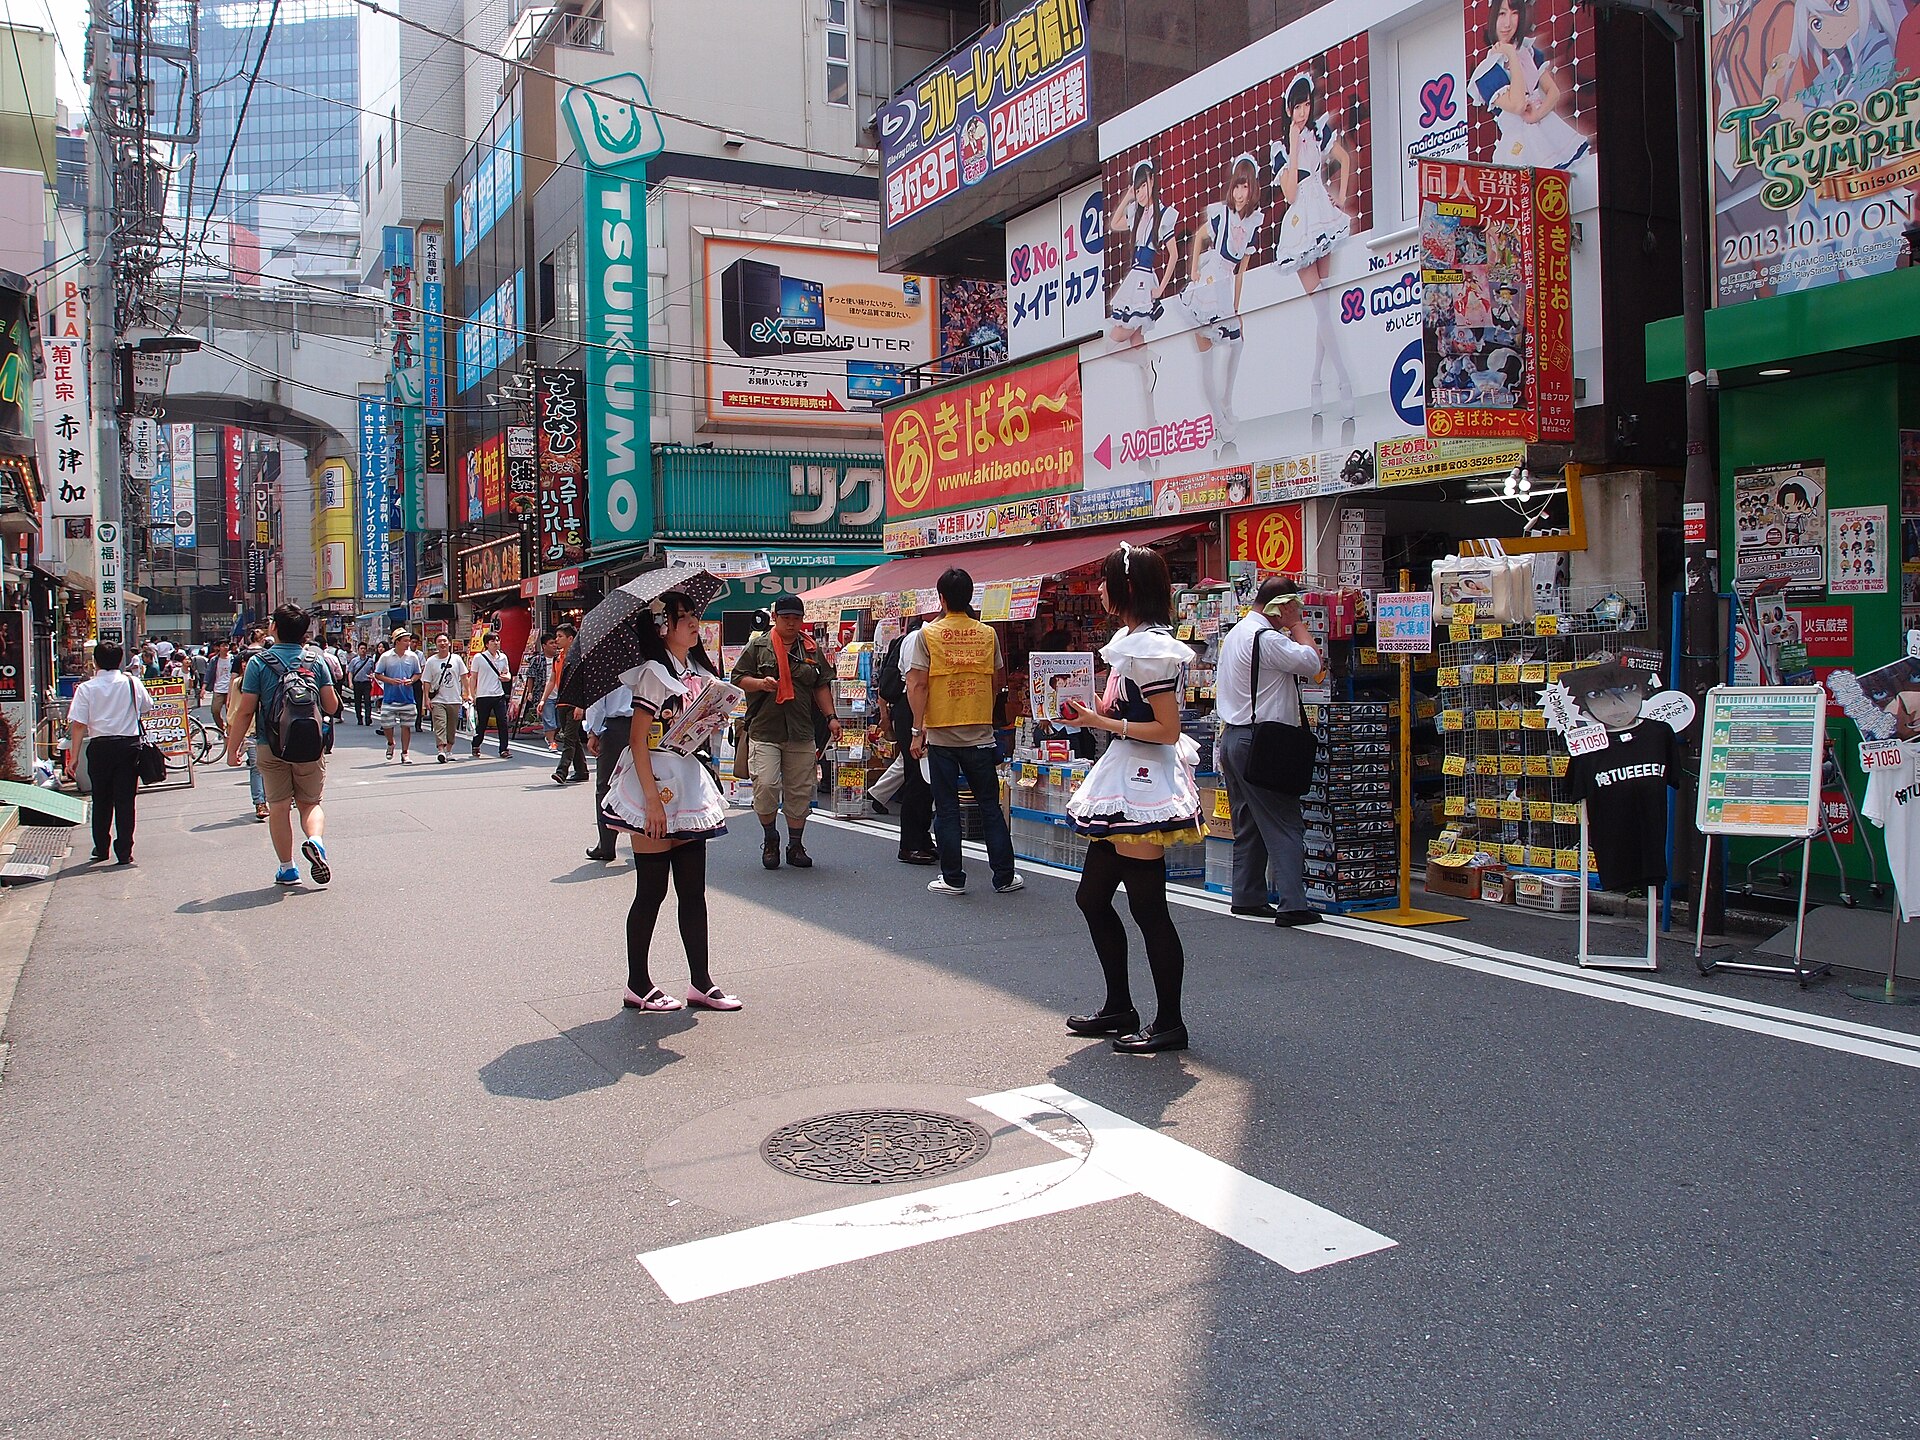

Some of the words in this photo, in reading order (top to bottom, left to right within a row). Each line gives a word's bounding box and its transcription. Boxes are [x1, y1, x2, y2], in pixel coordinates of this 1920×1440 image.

[993, 66, 1084, 162] 24時間営業
[889, 140, 956, 221] 受付3F
[1422, 163, 1476, 202] 同人
[1478, 169, 1518, 196] 音楽
[1847, 160, 1920, 195] Unisona
[1479, 196, 1521, 217] ソフト
[1478, 214, 1522, 236] グッズ
[1724, 210, 1850, 266] 2013.10.10
[1861, 193, 1914, 232] ON
[1032, 225, 1078, 277] No.1
[1794, 254, 1825, 268] NAMCO
[1827, 246, 1861, 261] BANDAI
[1862, 241, 1892, 253] Games
[426, 275, 439, 283] 6F
[1538, 225, 1549, 371] www.akibaoo.co.jp
[601, 182, 639, 533] TSUKUMO
[51, 344, 75, 402] 菊正宗
[748, 377, 809, 388] お見積りいたします
[728, 393, 833, 410] 本店1Fにて好評発売中!
[174, 424, 191, 434] BAR
[1061, 418, 1075, 433] TM
[1541, 416, 1571, 427] 同人フロア
[1120, 414, 1214, 464] 入り口は左手
[1380, 438, 1439, 458] まとめ買い
[54, 413, 87, 504] 赤津加
[1380, 453, 1440, 468] ご相談ください。
[937, 446, 1075, 492] www.akibaoo.co.jp
[518, 513, 531, 521] 2F
[541, 490, 565, 560] ハンバーグ
[177, 536, 193, 546] 2F
[101, 546, 118, 611] 福山歯科
[559, 576, 577, 588] docomo
[1804, 618, 1848, 633] 火気厳禁
[1716, 708, 1729, 717] 5F
[1569, 732, 1608, 753] ¥1050
[1714, 728, 1727, 737] 4F
[1712, 754, 1726, 763] 3F
[1862, 749, 1902, 769] ¥1050
[1710, 780, 1723, 789] 2F
[1708, 805, 1721, 814] 1F
